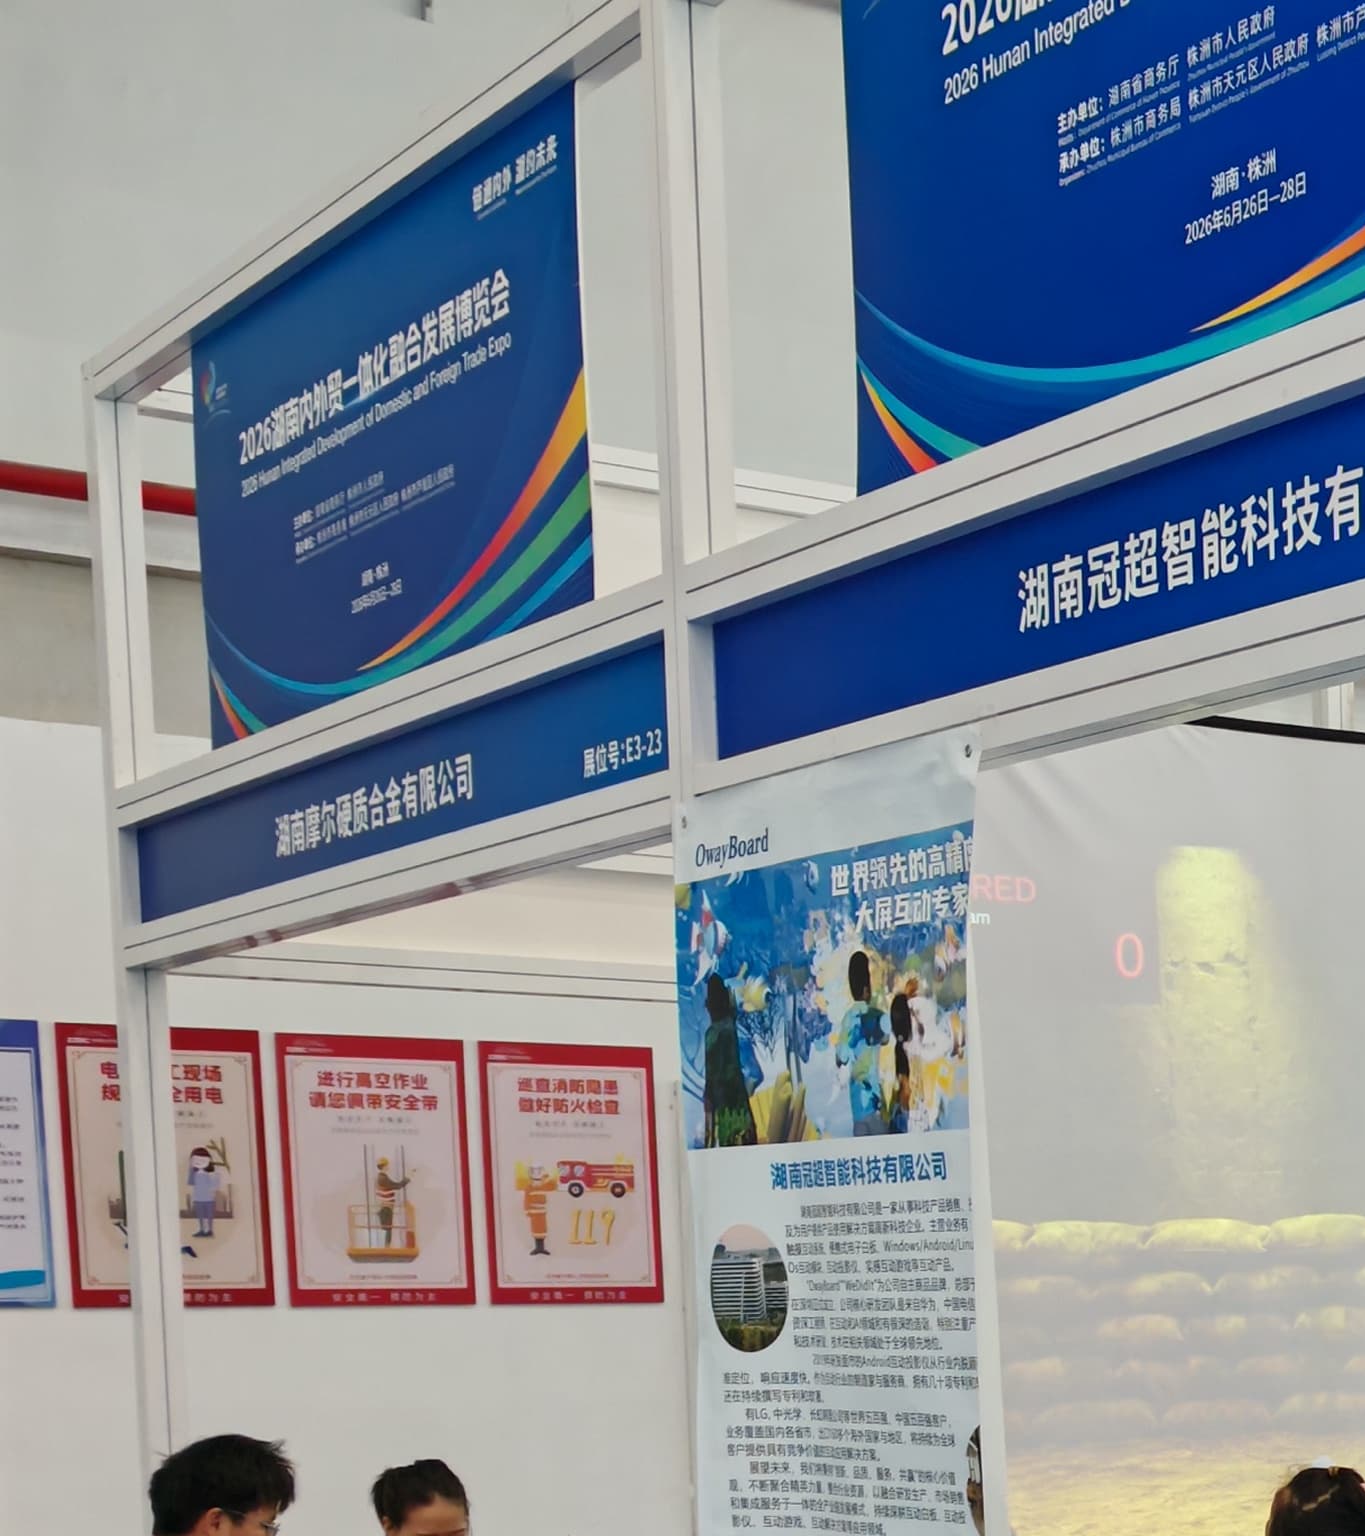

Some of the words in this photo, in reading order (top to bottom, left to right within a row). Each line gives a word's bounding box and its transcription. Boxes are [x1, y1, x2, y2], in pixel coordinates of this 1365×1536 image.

[944, 63, 978, 104] 2026
[982, 40, 1030, 83] Hunan
[1035, 0, 1115, 54] Integrated
[1108, 54, 1179, 108] 湖南省商务厅
[1187, 5, 1276, 68] 株洲市人民政府
[1110, 96, 1181, 148] 株洲市商务局
[1188, 33, 1309, 111] 株洲市天元区人民政府
[1211, 148, 1277, 200] 湖南·株洲
[239, 268, 510, 465] 2026湖南内外贸一体化融合发展博览会
[488, 332, 512, 358] Expo
[583, 729, 663, 778] 展位号:E3-23
[275, 753, 474, 858] 湖南摩尔硬质合金有限公司
[696, 828, 769, 868] OwayBoard
[855, 882, 970, 934] 大屏互动专家
[971, 873, 1037, 903] RED
[1114, 932, 1145, 979] 0
[317, 1071, 428, 1090] 进行高空作业
[517, 1077, 619, 1096] 巡查消防隐患
[518, 1096, 621, 1116] 做好防火检查
[770, 1152, 947, 1190] 湖南冠超智能科技有限公司
